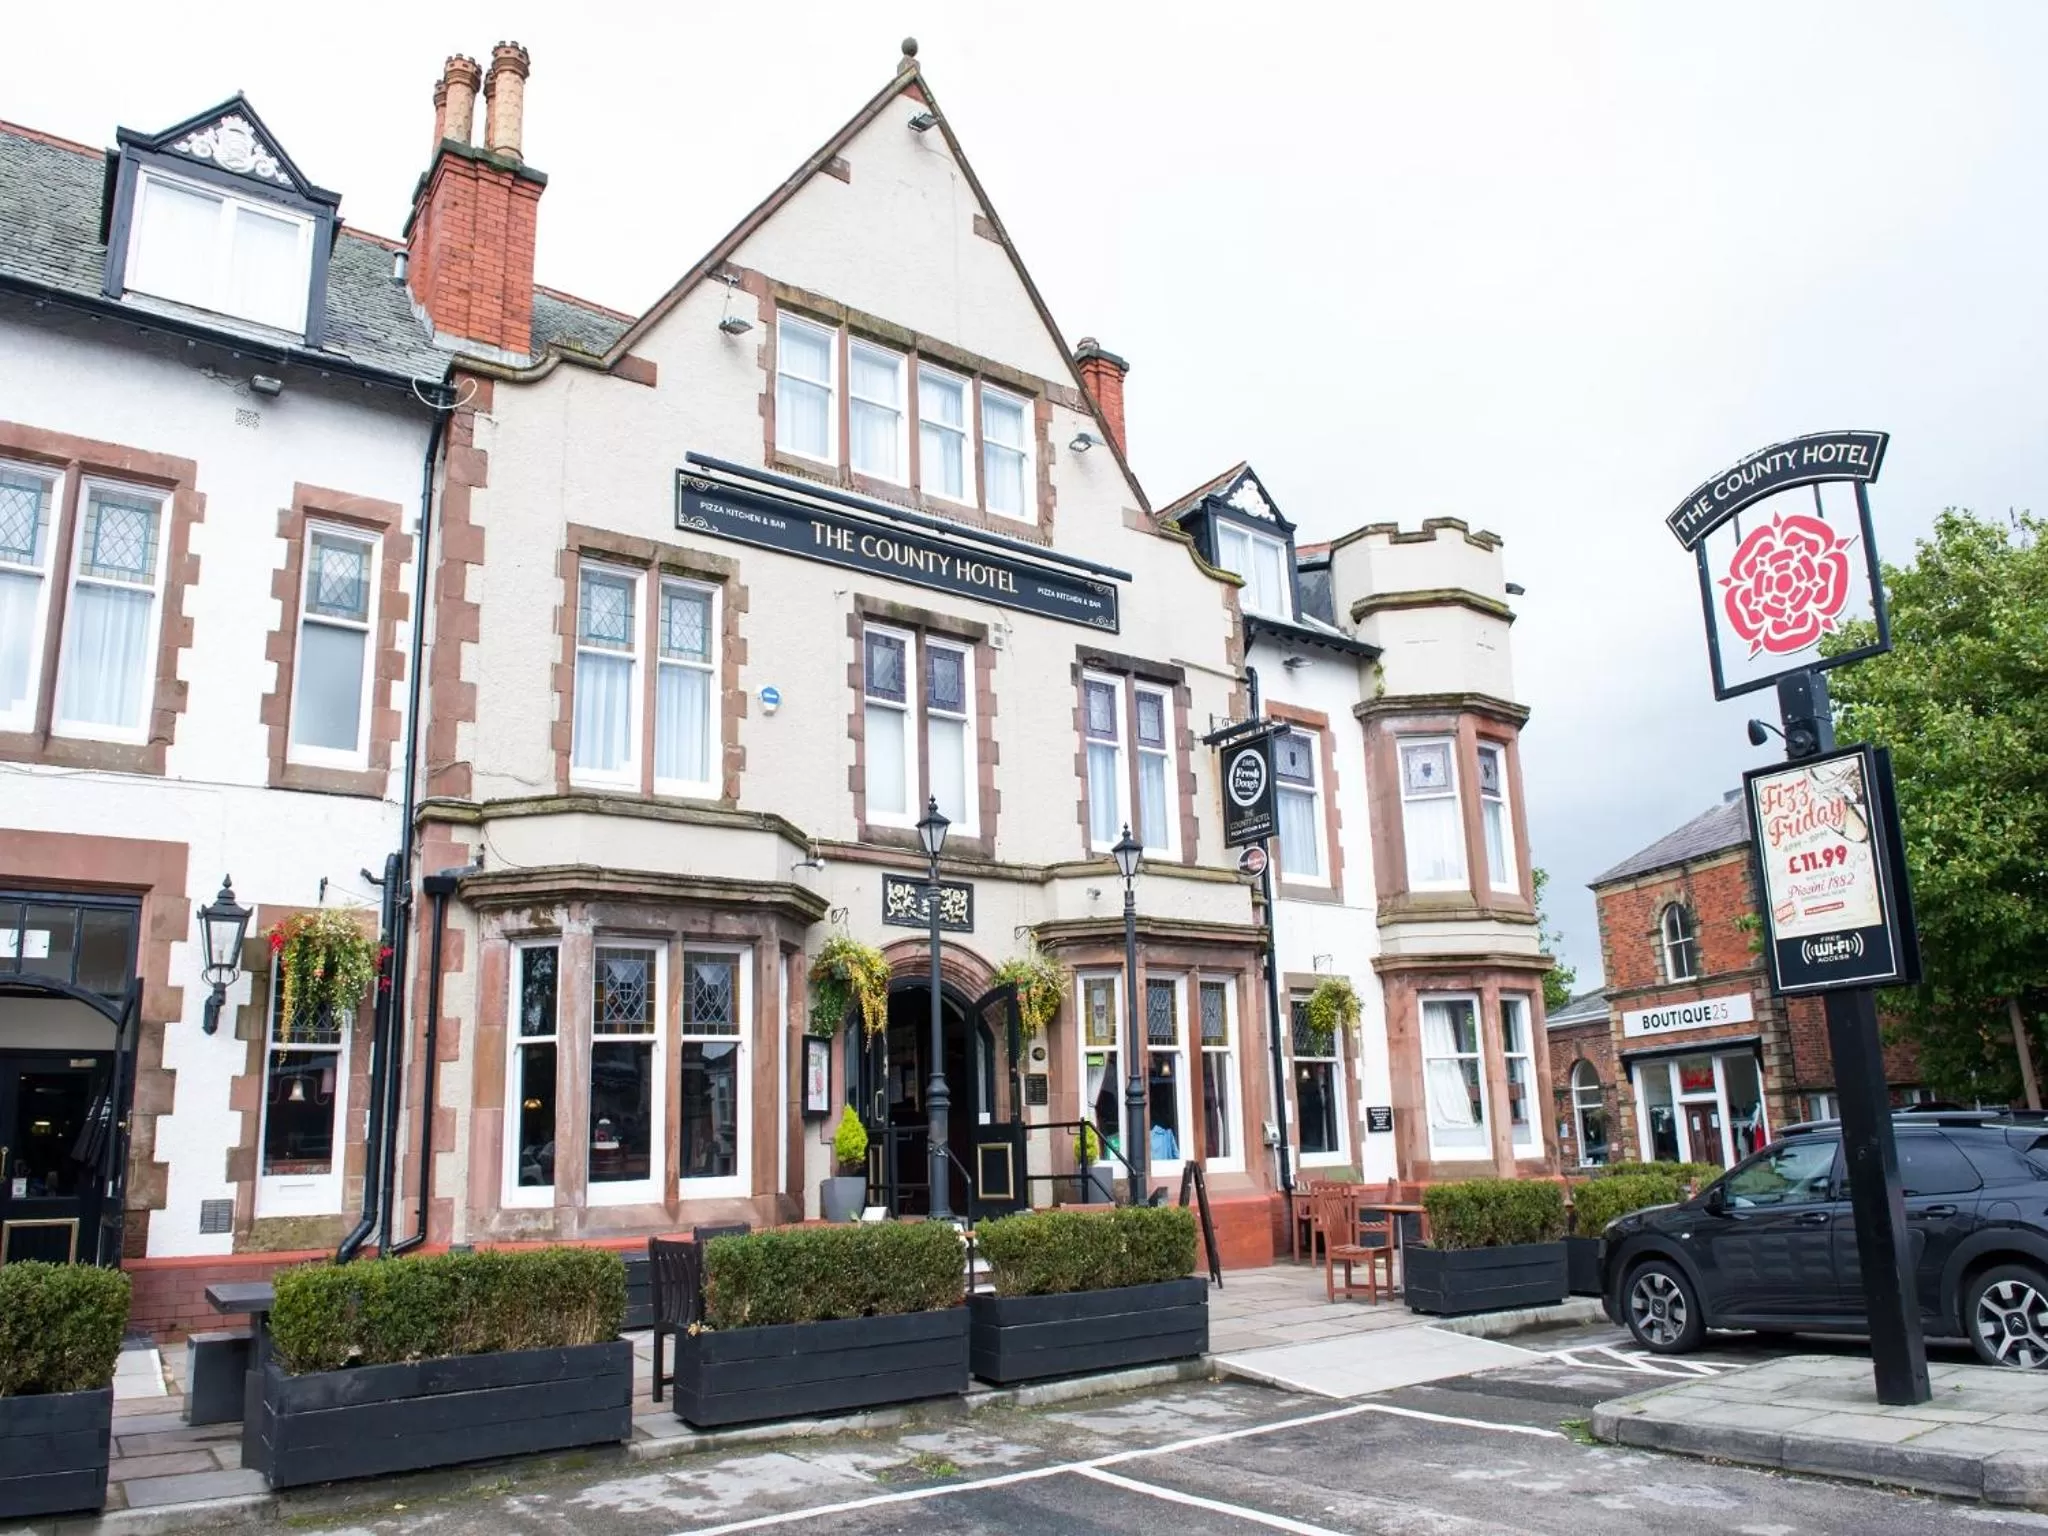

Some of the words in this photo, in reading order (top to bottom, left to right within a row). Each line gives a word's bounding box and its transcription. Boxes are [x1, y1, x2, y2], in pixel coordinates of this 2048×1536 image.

[1675, 495, 1713, 532] THE
[1713, 448, 1798, 501] COUNTY
[1802, 443, 1870, 466] HOTEL
[700, 501, 724, 514] PIZZA
[725, 507, 761, 523] KITCHEN
[769, 518, 786, 531] BAR
[811, 520, 855, 553] THE
[860, 534, 950, 576] COUNTY
[956, 558, 1019, 594] HOTEL
[1037, 586, 1055, 598] PIZZA
[1760, 779, 1808, 815] Fizz
[1768, 797, 1848, 847] Friday
[1789, 845, 1847, 874] £11.99
[1827, 872, 1855, 891] 1882
[1818, 953, 1849, 963] ACCESS
